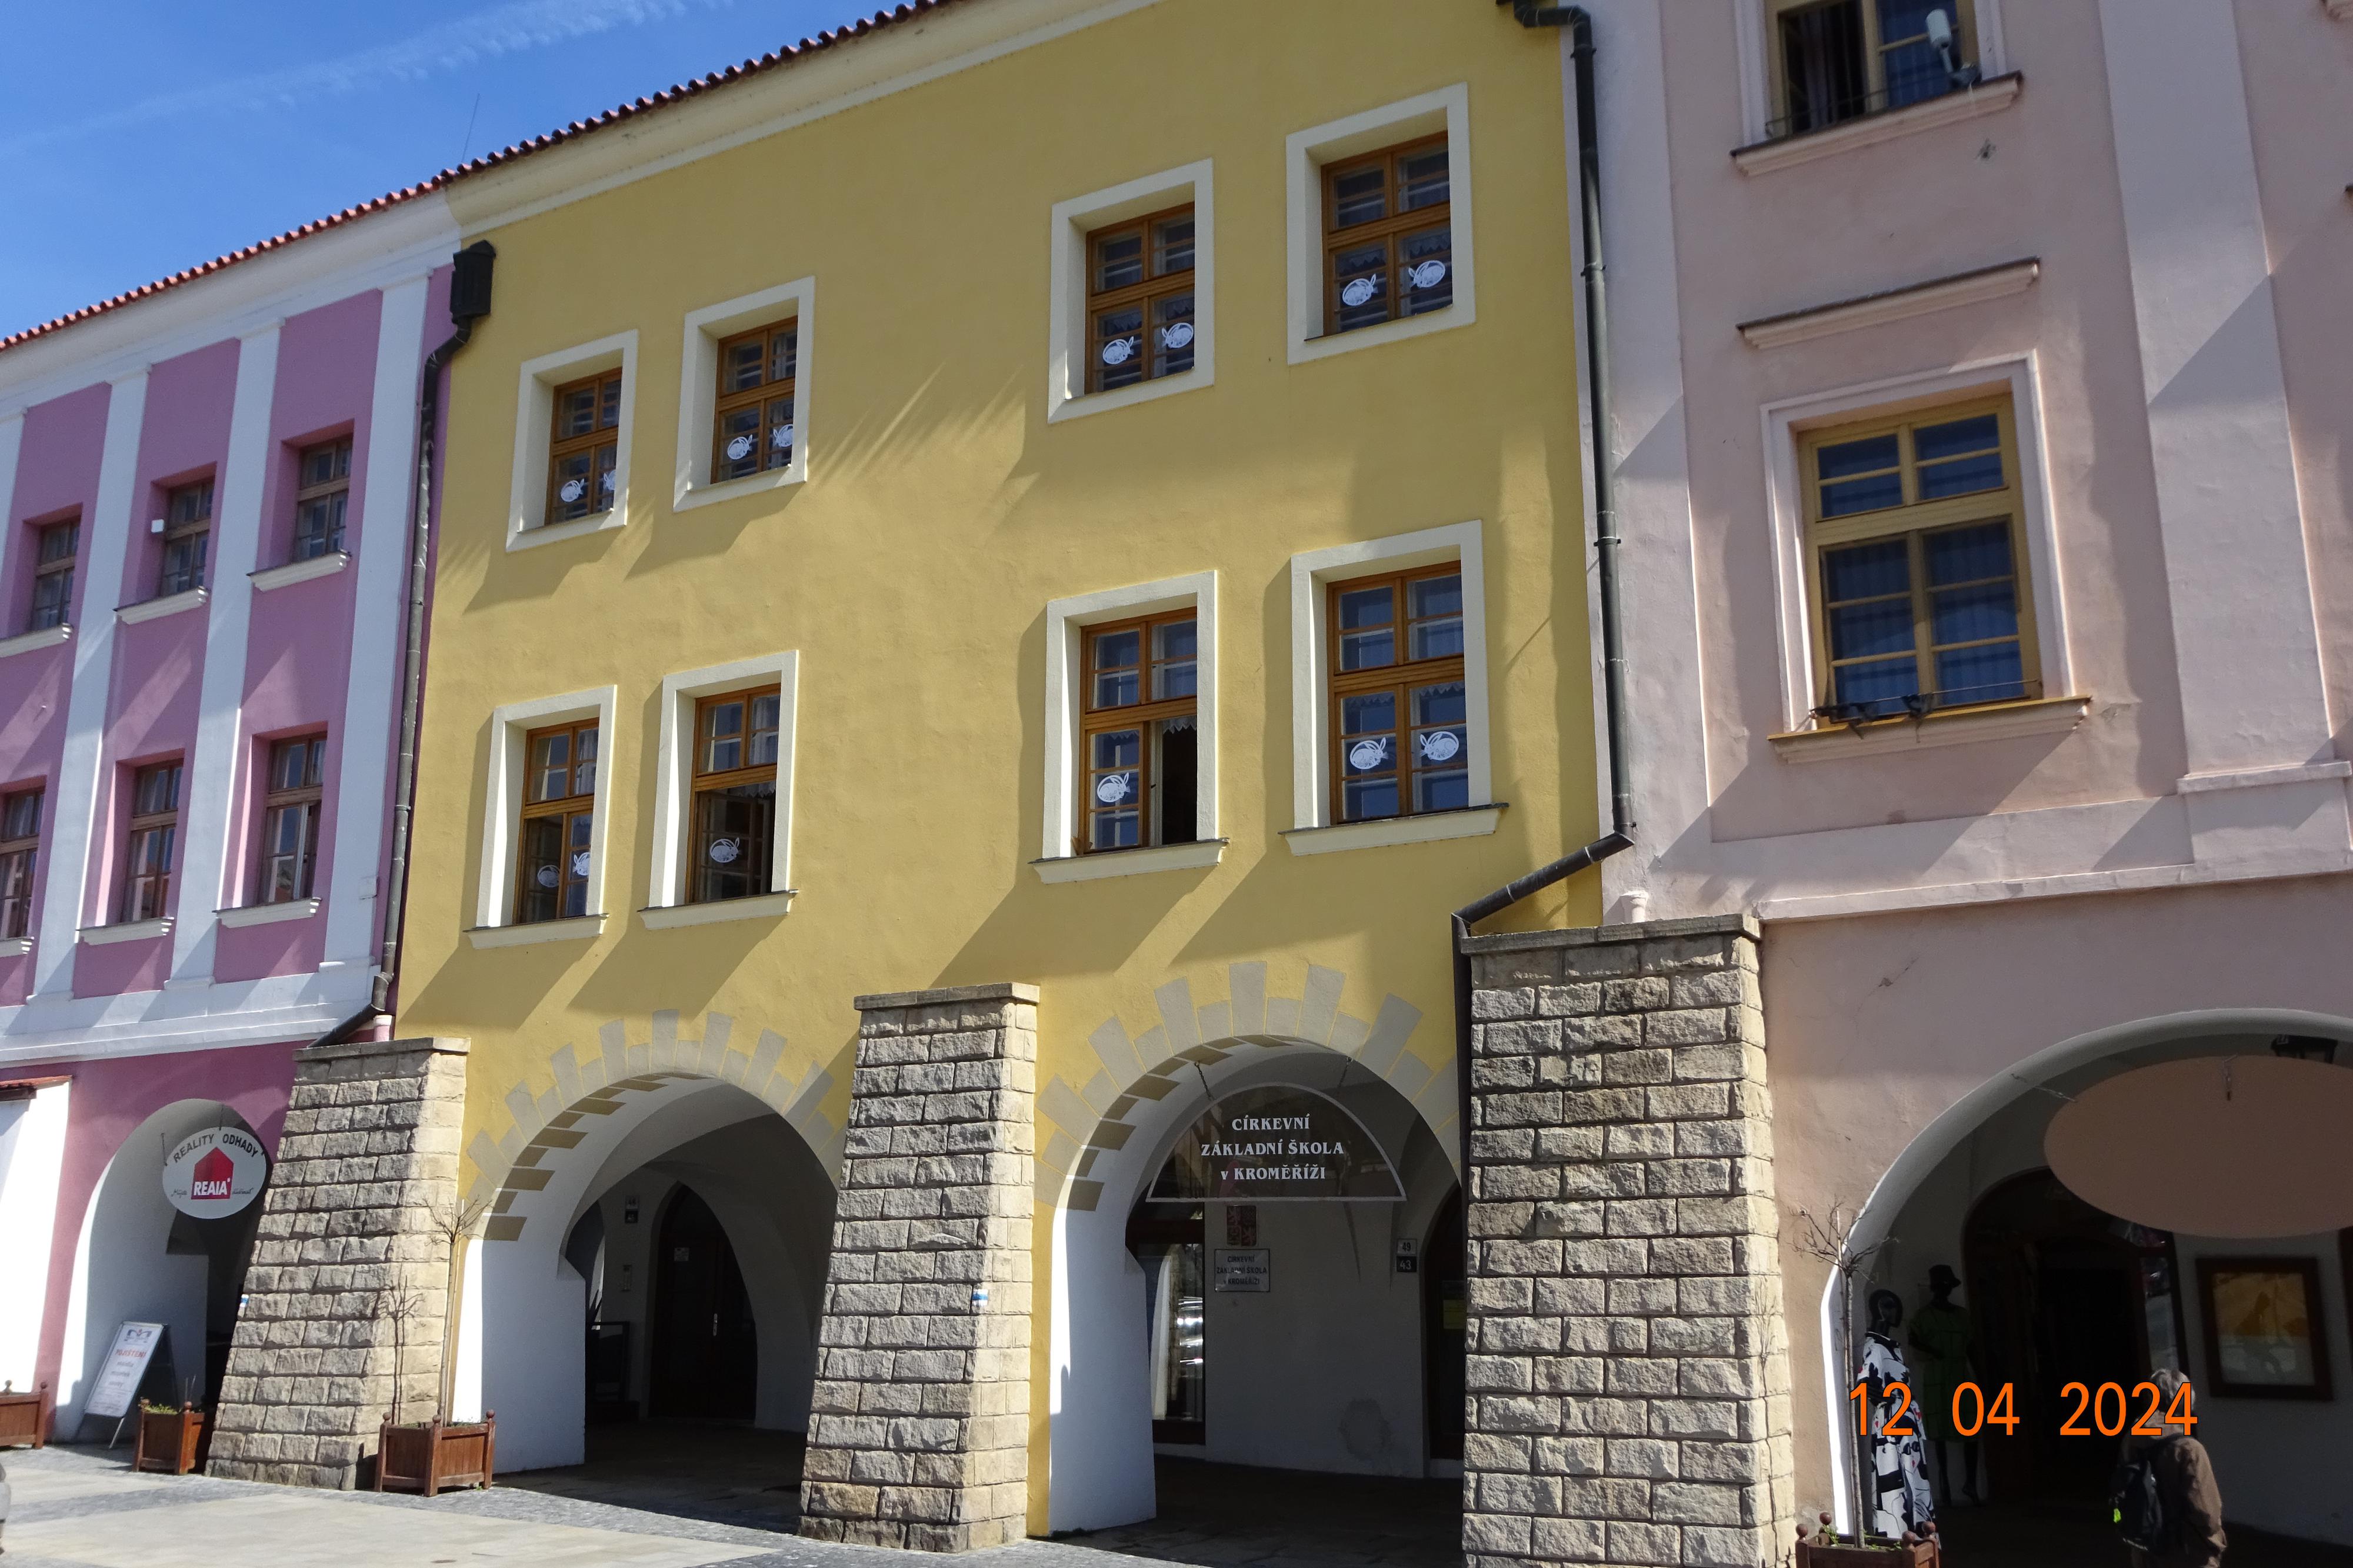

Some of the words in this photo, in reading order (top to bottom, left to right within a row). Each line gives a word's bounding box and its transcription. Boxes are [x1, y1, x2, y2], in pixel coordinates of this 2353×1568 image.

[1232, 1113, 1311, 1130] CÍRKEVNÍ
[173, 1134, 214, 1163] REALITY
[222, 1134, 259, 1157] ODHADY
[1201, 1139, 1284, 1156] ZÁKLADNÍ
[1288, 1139, 1345, 1155] ŠKOLA
[1221, 1171, 1229, 1180] v
[1234, 1163, 1326, 1180] KROMĚŘÍŽI
[1402, 1242, 1411, 1252] 49
[1399, 1259, 1412, 1270] 43
